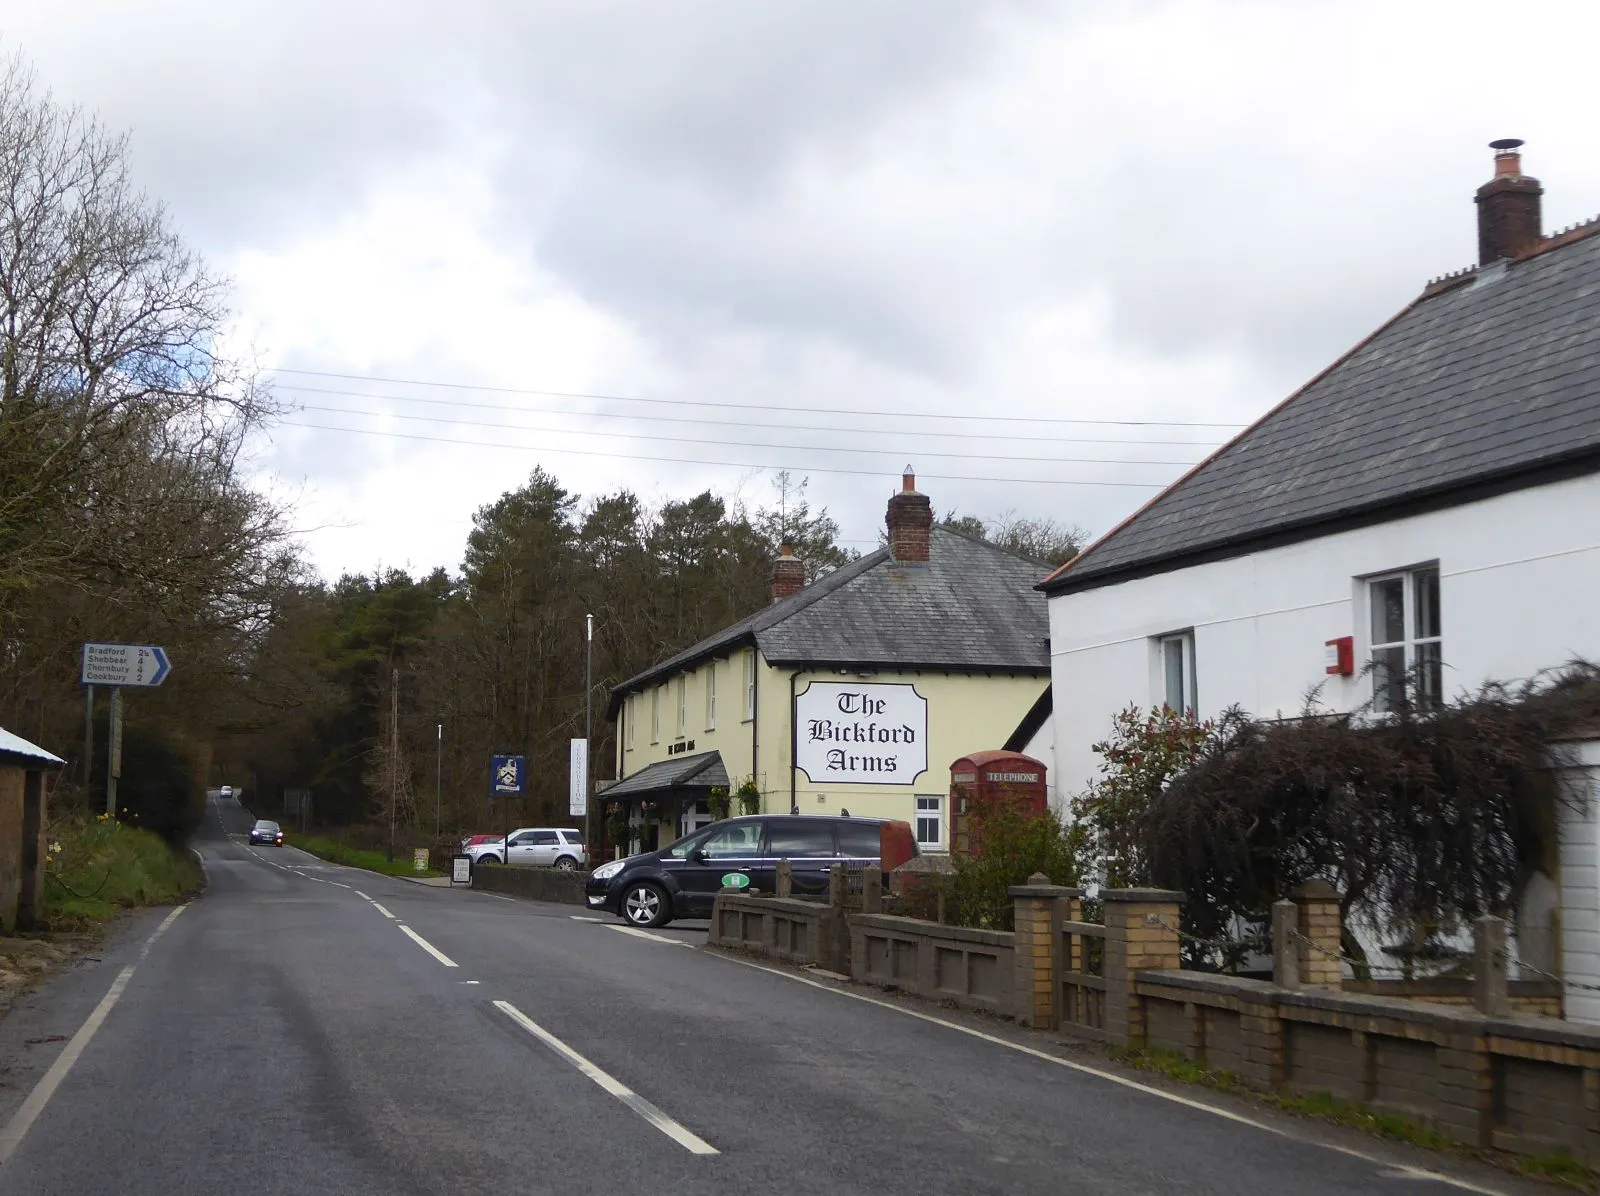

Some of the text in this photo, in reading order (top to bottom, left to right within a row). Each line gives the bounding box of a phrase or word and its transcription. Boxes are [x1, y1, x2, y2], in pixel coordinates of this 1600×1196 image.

[88, 646, 125, 655] Bradford
[88, 655, 144, 665] Shebbear 4
[87, 663, 130, 673] Thornbury
[86, 672, 143, 682] Cookbury 2
[836, 692, 887, 718] The
[807, 719, 915, 744] Bickford
[826, 748, 898, 772] Arms
[988, 772, 1038, 782] TELEPHONE
